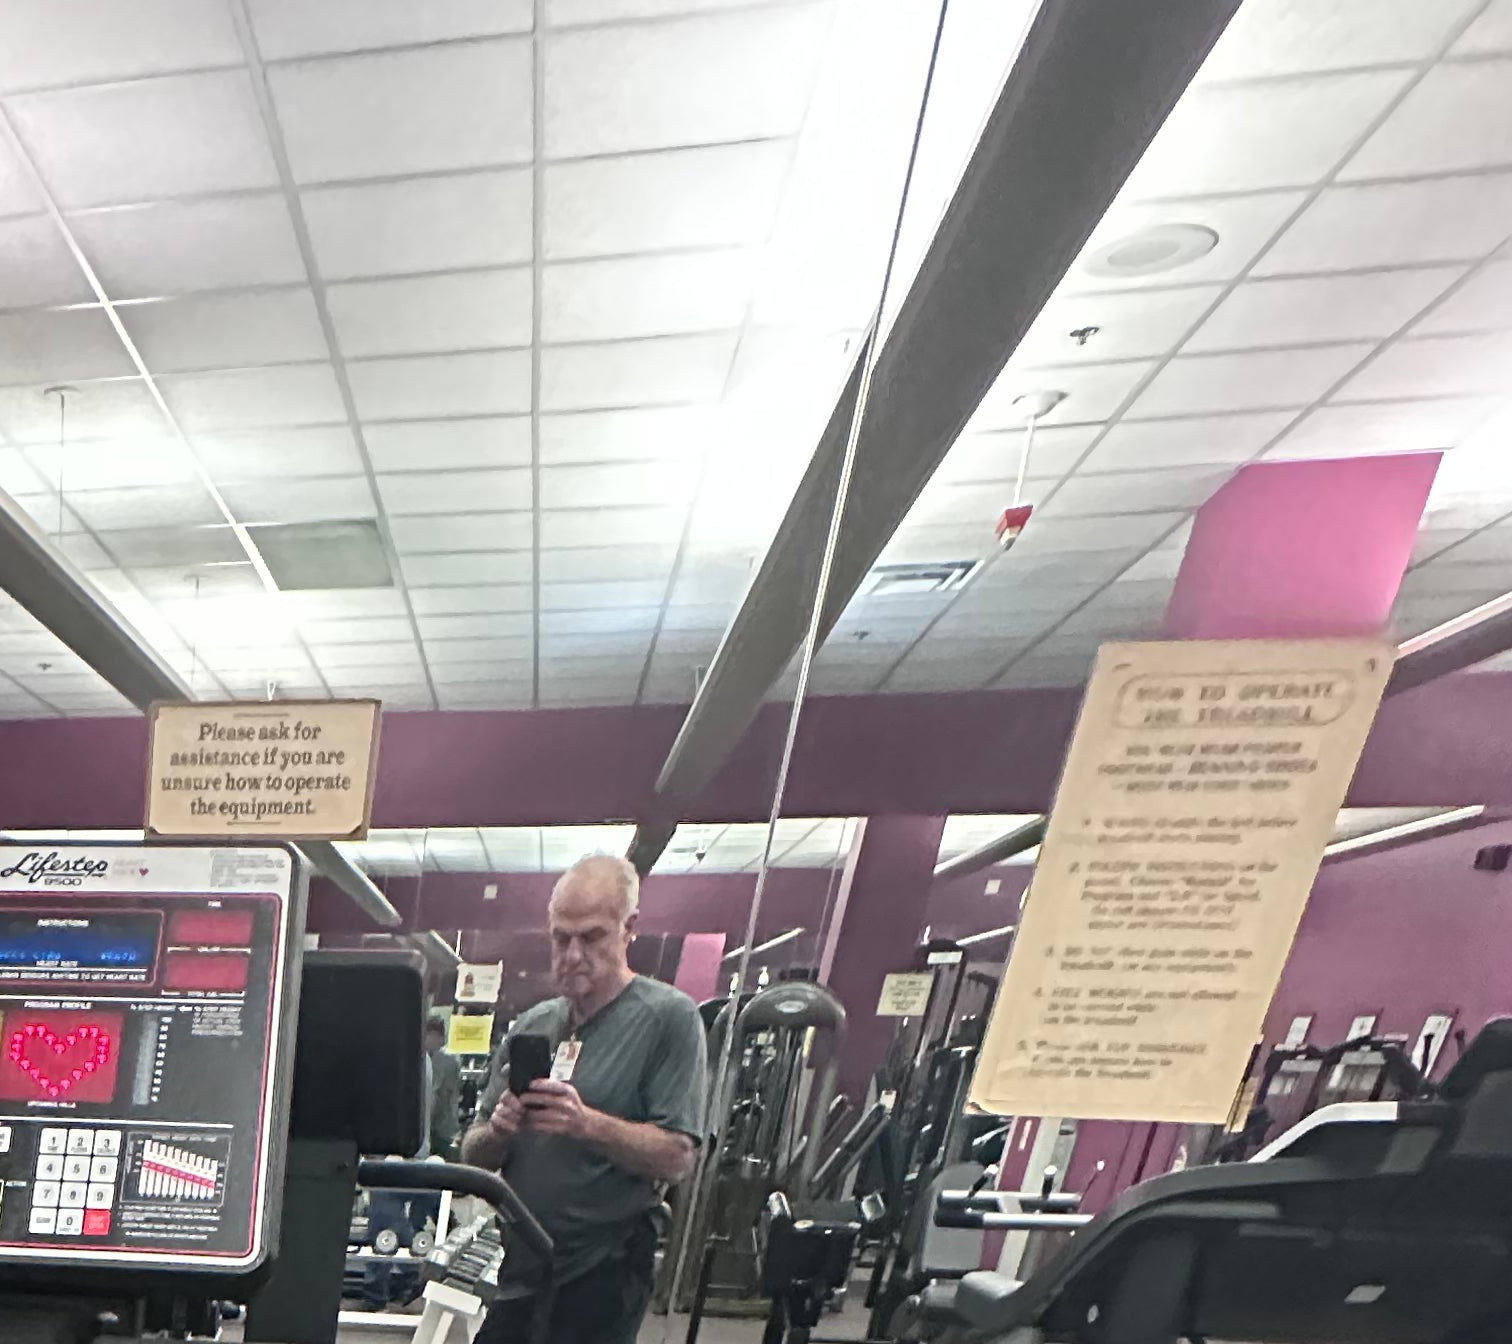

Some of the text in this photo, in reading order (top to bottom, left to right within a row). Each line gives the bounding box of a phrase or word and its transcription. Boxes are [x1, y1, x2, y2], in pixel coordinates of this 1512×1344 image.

[197, 720, 322, 742] Please ask for
[169, 747, 345, 771] assistance if you are
[160, 772, 352, 796] unsure how to operate
[190, 797, 317, 820] the equipment.
[0, 851, 109, 884] Lifestep
[43, 877, 83, 886] 9500
